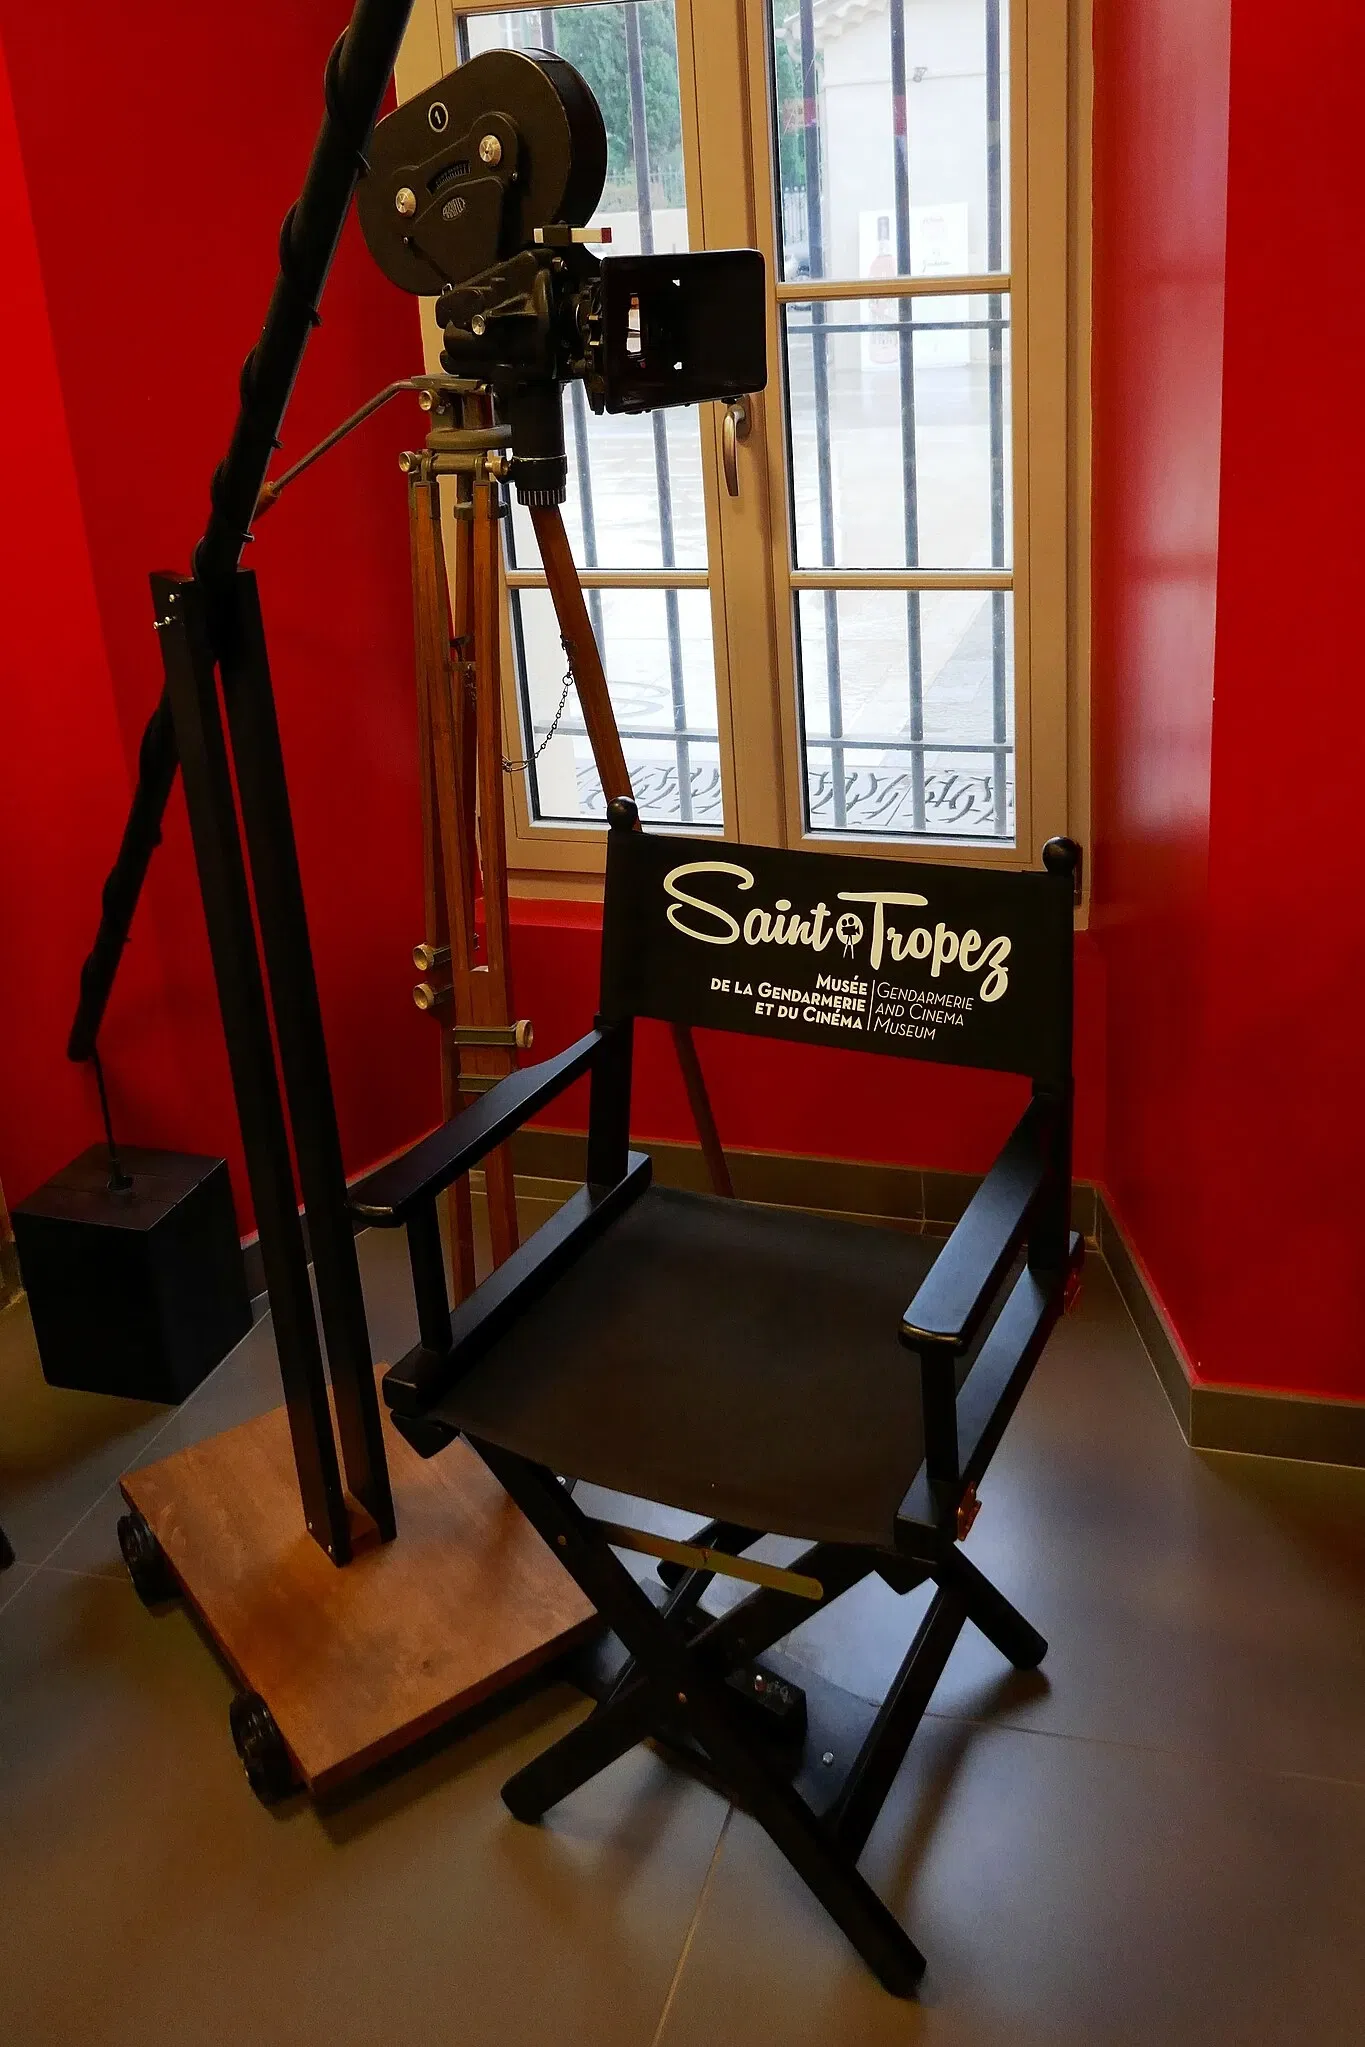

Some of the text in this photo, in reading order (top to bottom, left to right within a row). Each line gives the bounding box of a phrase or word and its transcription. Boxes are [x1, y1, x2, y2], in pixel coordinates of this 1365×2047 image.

[434, 110, 442, 125] 1
[662, 860, 1012, 1003] Saint Tropez
[710, 977, 731, 993] DE
[734, 981, 753, 996] LA
[754, 1001, 775, 1016] ET
[777, 1004, 799, 1020] DU
[874, 1002, 905, 1018] AND
